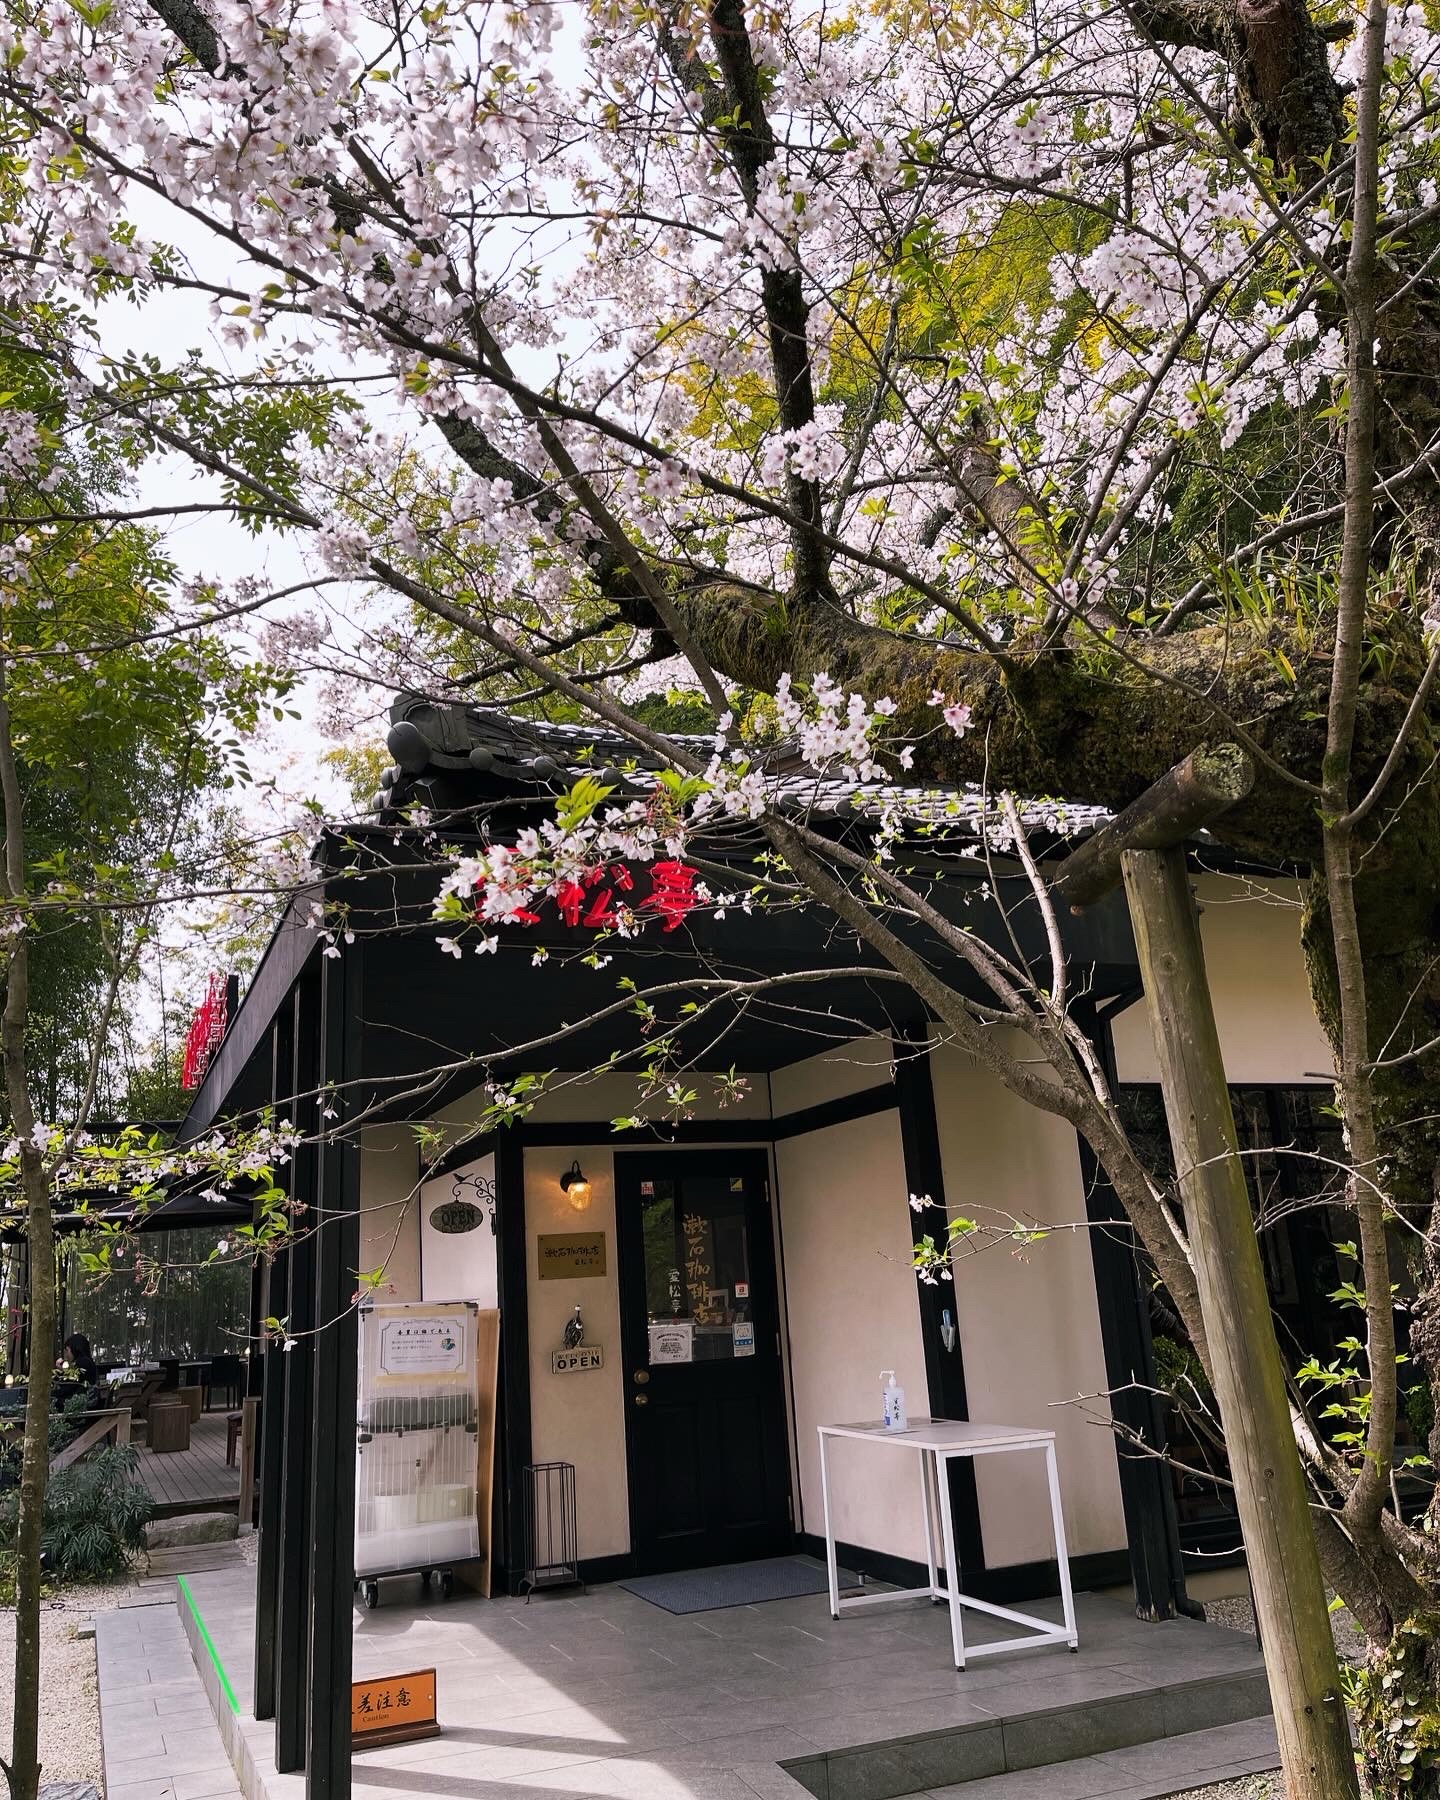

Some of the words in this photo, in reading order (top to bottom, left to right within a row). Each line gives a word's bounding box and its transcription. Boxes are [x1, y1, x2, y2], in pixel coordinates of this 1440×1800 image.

[442, 1209, 475, 1225] OPEN
[682, 1213, 710, 1325] 漱石珈琲店
[557, 1349, 600, 1360] WELCOME
[557, 1355, 600, 1370] OPEN
[352, 1688, 411, 1714] 差注意
[362, 1712, 390, 1723] Caution
